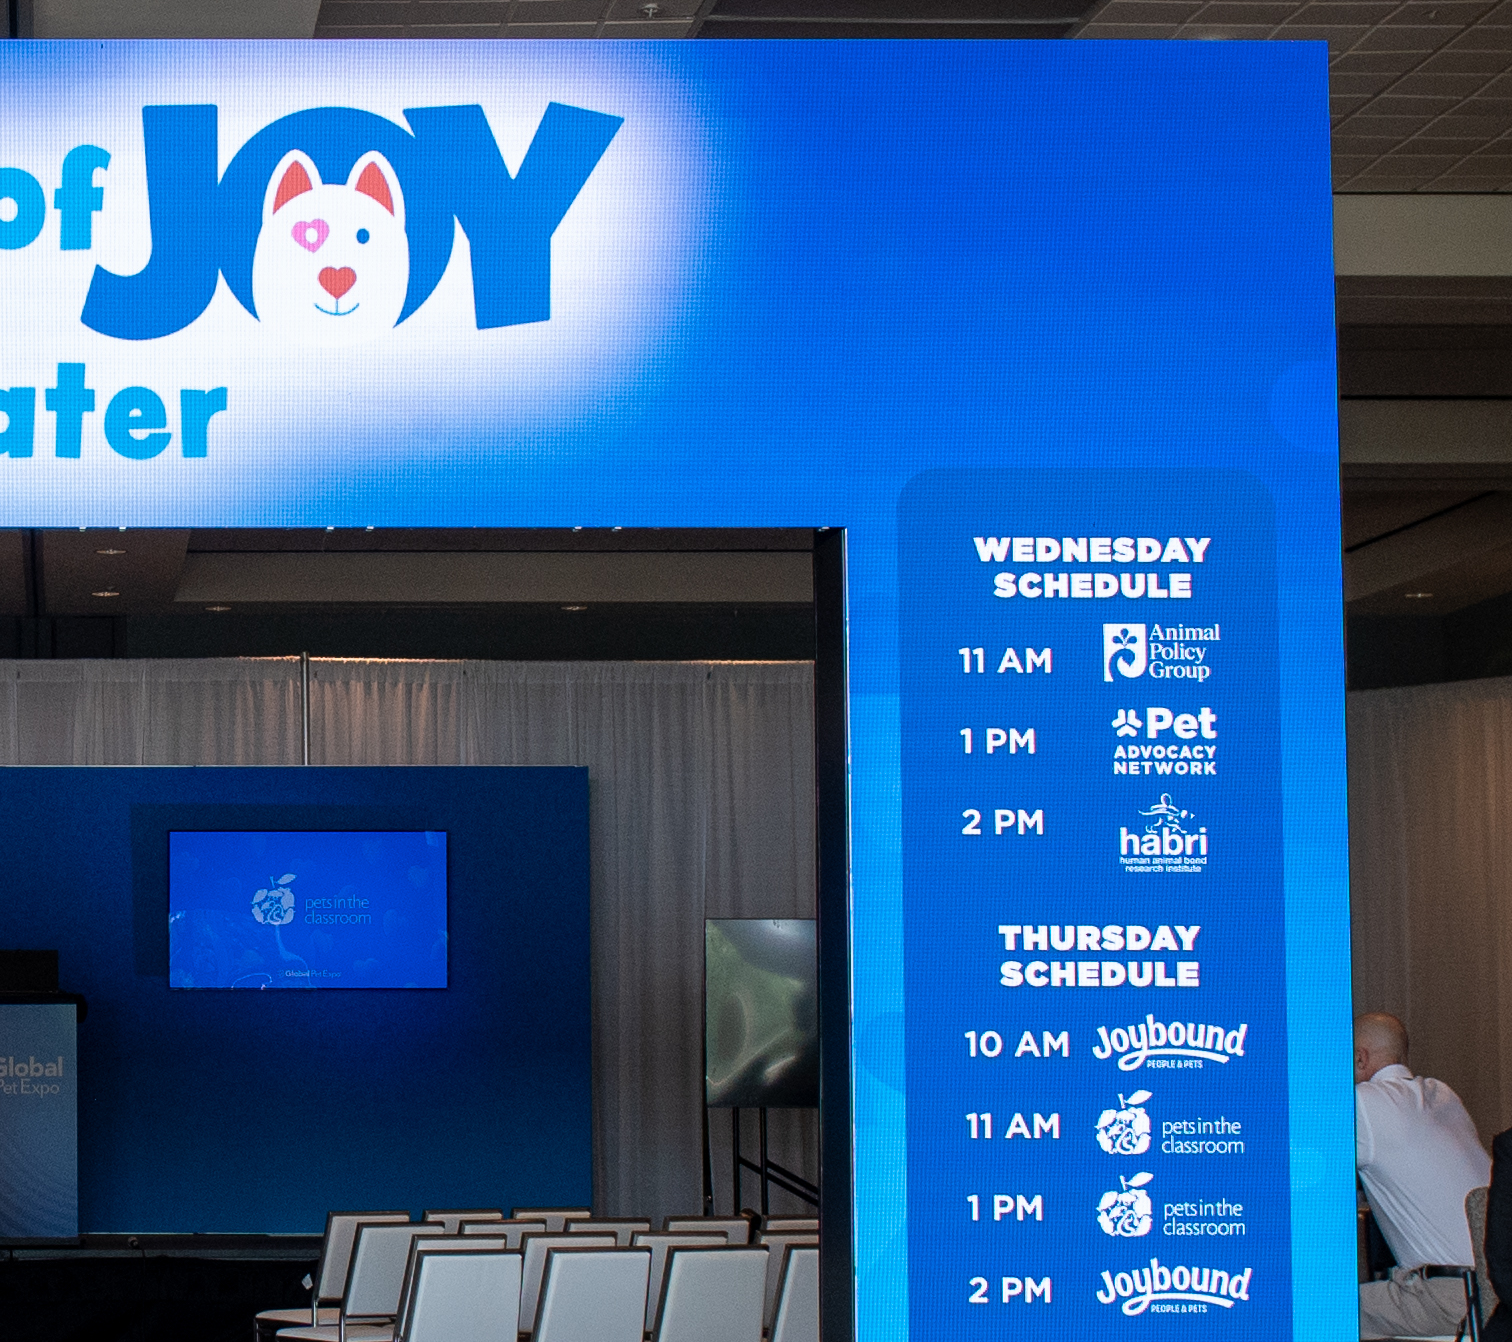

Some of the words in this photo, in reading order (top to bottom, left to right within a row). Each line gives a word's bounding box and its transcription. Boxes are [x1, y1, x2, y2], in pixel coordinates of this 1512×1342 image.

[80, 101, 625, 341] JOY
[974, 537, 1211, 562] WEDNESDAY
[994, 573, 1191, 598] SCHEDULE
[1150, 624, 1220, 640] Animal
[959, 648, 983, 673] 11
[998, 648, 1051, 673] AM
[1150, 642, 1204, 663] Policy
[1149, 661, 1209, 682] Group
[1147, 708, 1217, 739] Pet
[961, 728, 971, 753] 1
[987, 729, 1035, 754] PM
[1115, 745, 1216, 758] ADVOCACY
[1114, 762, 1216, 774] NETWORK
[963, 809, 981, 834] 2
[995, 810, 1043, 834] PM
[1120, 826, 1207, 855] habri
[304, 911, 371, 925] classroom
[999, 926, 1200, 950] THURSDAY
[1001, 961, 1199, 986] SCHEDULE
[965, 1031, 1002, 1057] 10
[1015, 1031, 1069, 1057] AM
[1093, 1014, 1247, 1071] Joybound
[20, 1078, 60, 1099] Expo
[967, 1113, 991, 1138] 11
[1006, 1113, 1059, 1138] AM
[1162, 1136, 1243, 1153] classroom
[968, 1195, 978, 1221] 1
[994, 1195, 1042, 1221] PM
[1164, 1218, 1245, 1235] classroom
[969, 1277, 988, 1303] 2
[1003, 1277, 1051, 1303] PM
[1097, 1258, 1251, 1315] Joybound
